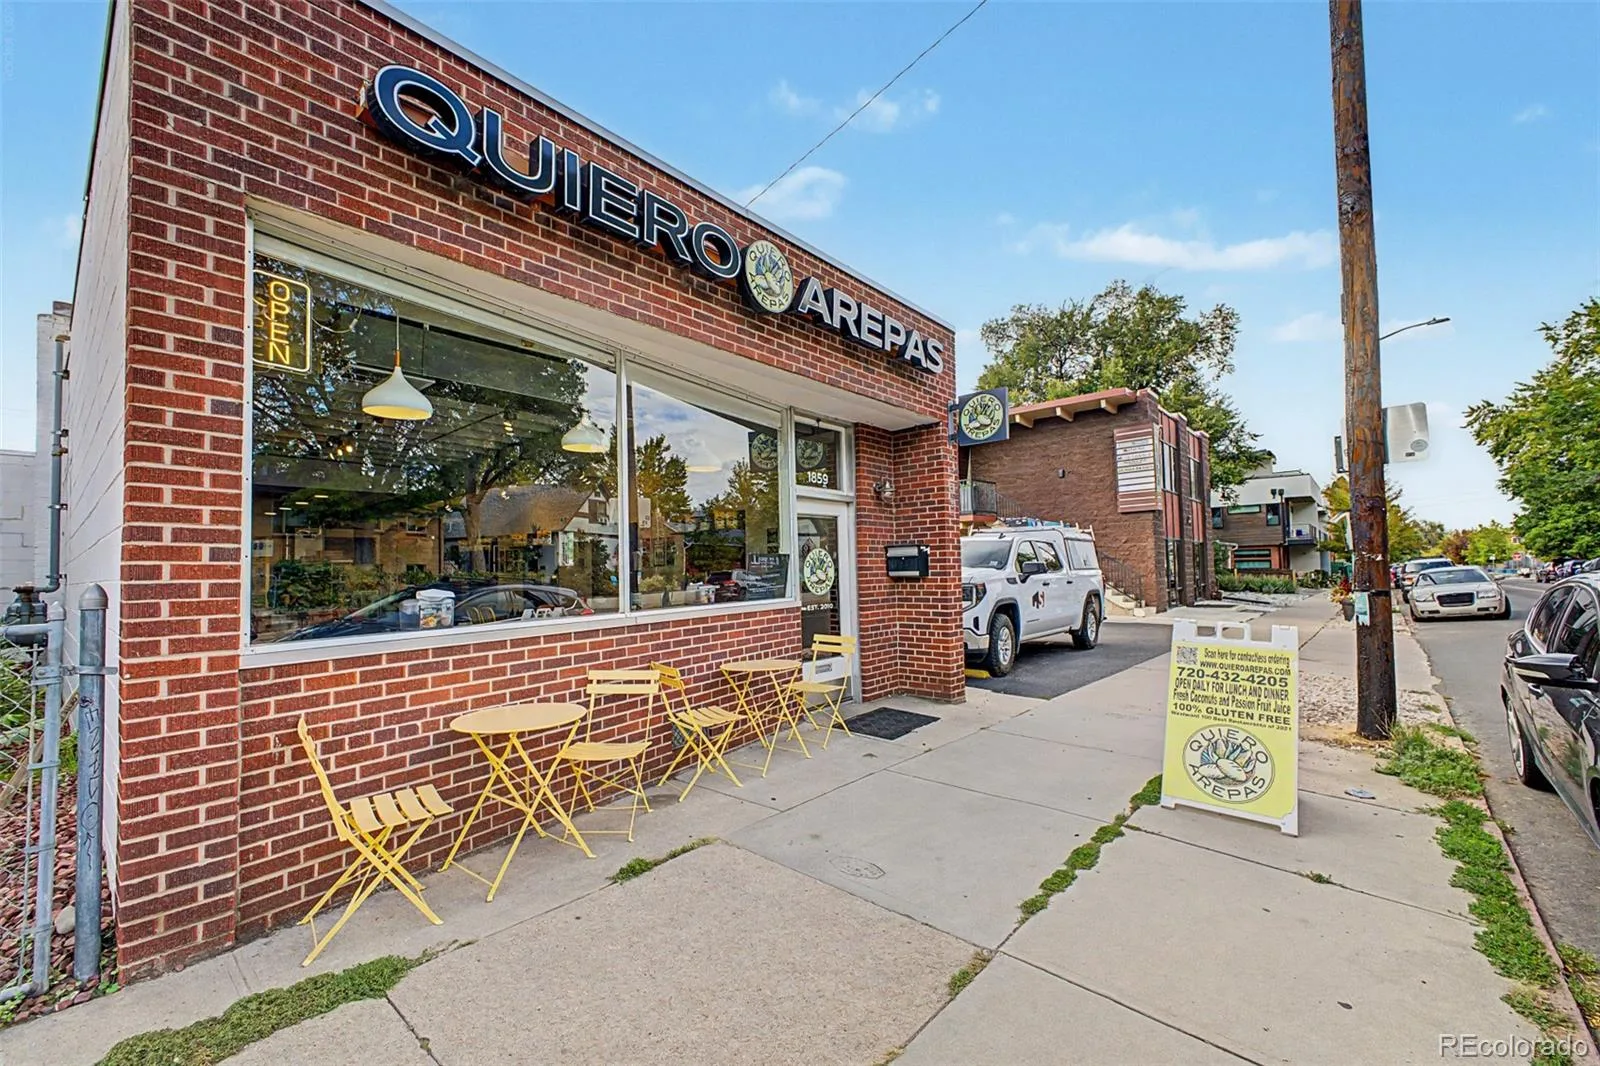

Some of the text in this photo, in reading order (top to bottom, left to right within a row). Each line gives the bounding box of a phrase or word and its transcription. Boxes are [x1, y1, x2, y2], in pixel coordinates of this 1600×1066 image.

[372, 64, 741, 279] QUIERO
[749, 243, 791, 282] QUIERO
[748, 271, 789, 309] AREPAS
[270, 281, 290, 365] OPEN
[798, 276, 944, 374] AREPAS
[963, 395, 1001, 417] QUIERO
[963, 418, 1000, 438] AREPAS
[807, 472, 829, 485] 1859
[1204, 647, 1216, 659] Scan
[1217, 649, 1228, 660] here
[1237, 652, 1266, 664] contactless
[1267, 654, 1290, 669] ordering
[1174, 678, 1289, 701] OPEN DAILY FOR LUNCH AND DINNER
[1177, 667, 1288, 688] 720-432-4205
[1173, 688, 1291, 715] Fresh Coconuts and Passion Fruit Juice
[1173, 702, 1291, 726] 100% GLUTEN FREE
[1189, 728, 1268, 764] QUIERO
[1189, 763, 1265, 799] AREPAS
